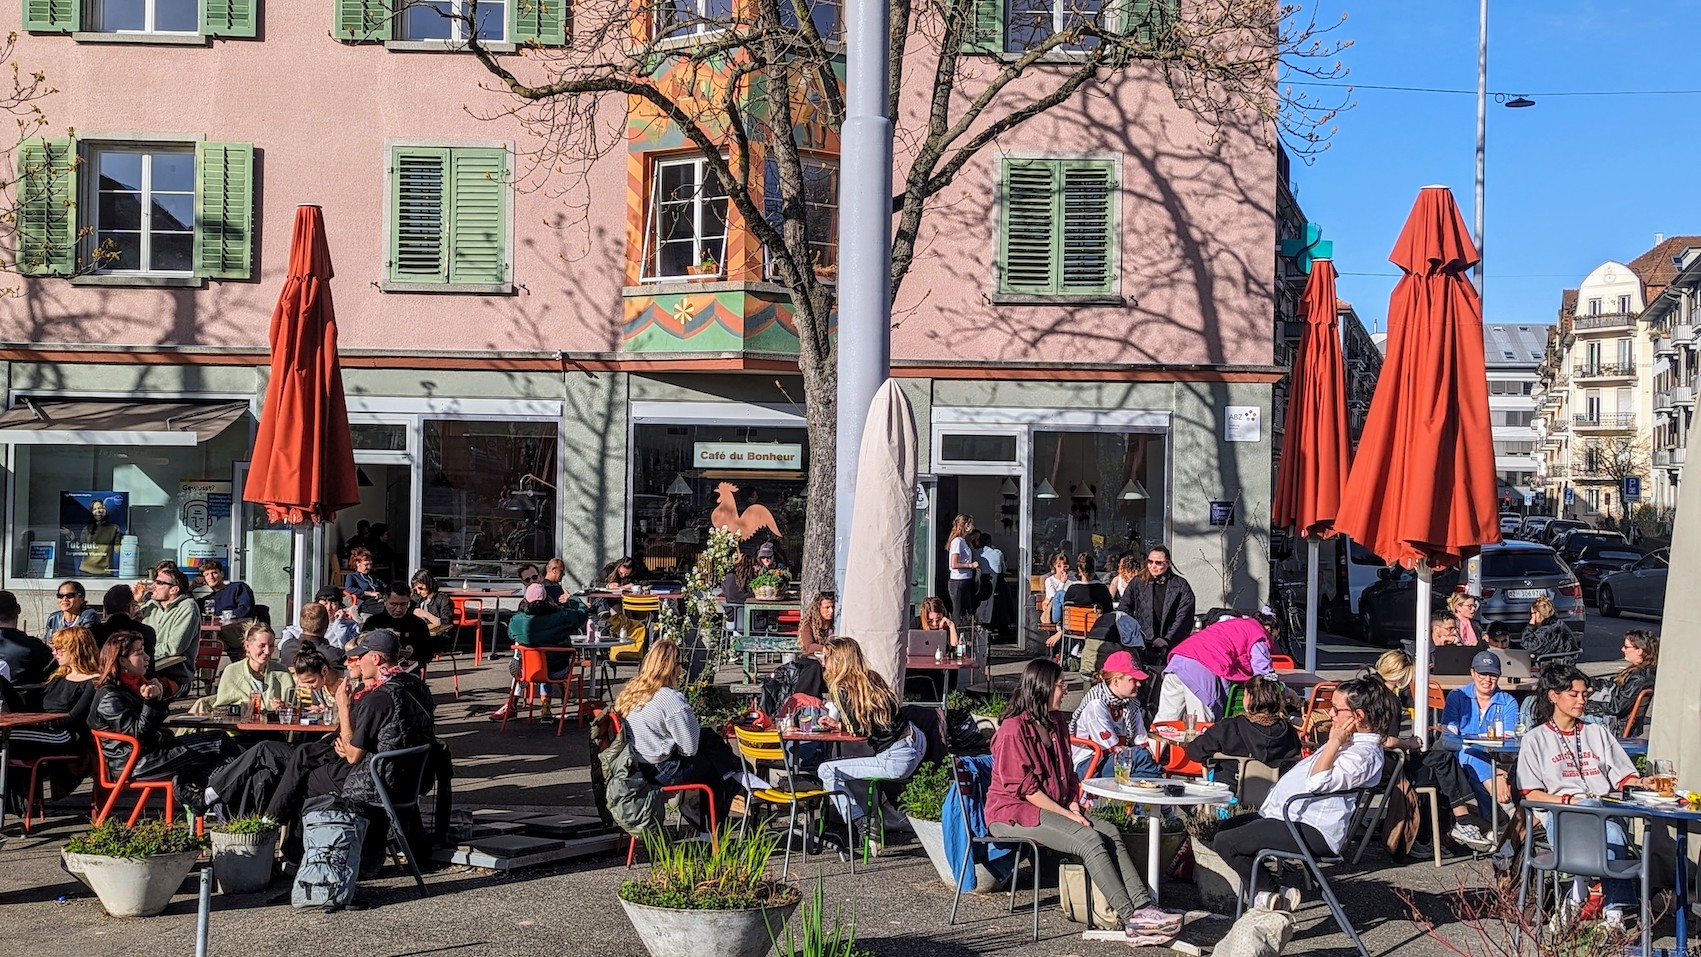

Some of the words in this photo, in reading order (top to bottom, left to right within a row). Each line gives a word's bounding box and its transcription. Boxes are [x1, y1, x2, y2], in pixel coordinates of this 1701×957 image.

[1228, 413, 1243, 421] ABZ
[700, 450, 726, 460] Café
[729, 451, 744, 461] du
[747, 451, 795, 461] Bonheur
[182, 484, 216, 492] Gewusst?
[1629, 479, 1636, 488] P
[66, 540, 80, 549] Tut
[81, 541, 99, 551] gut.
